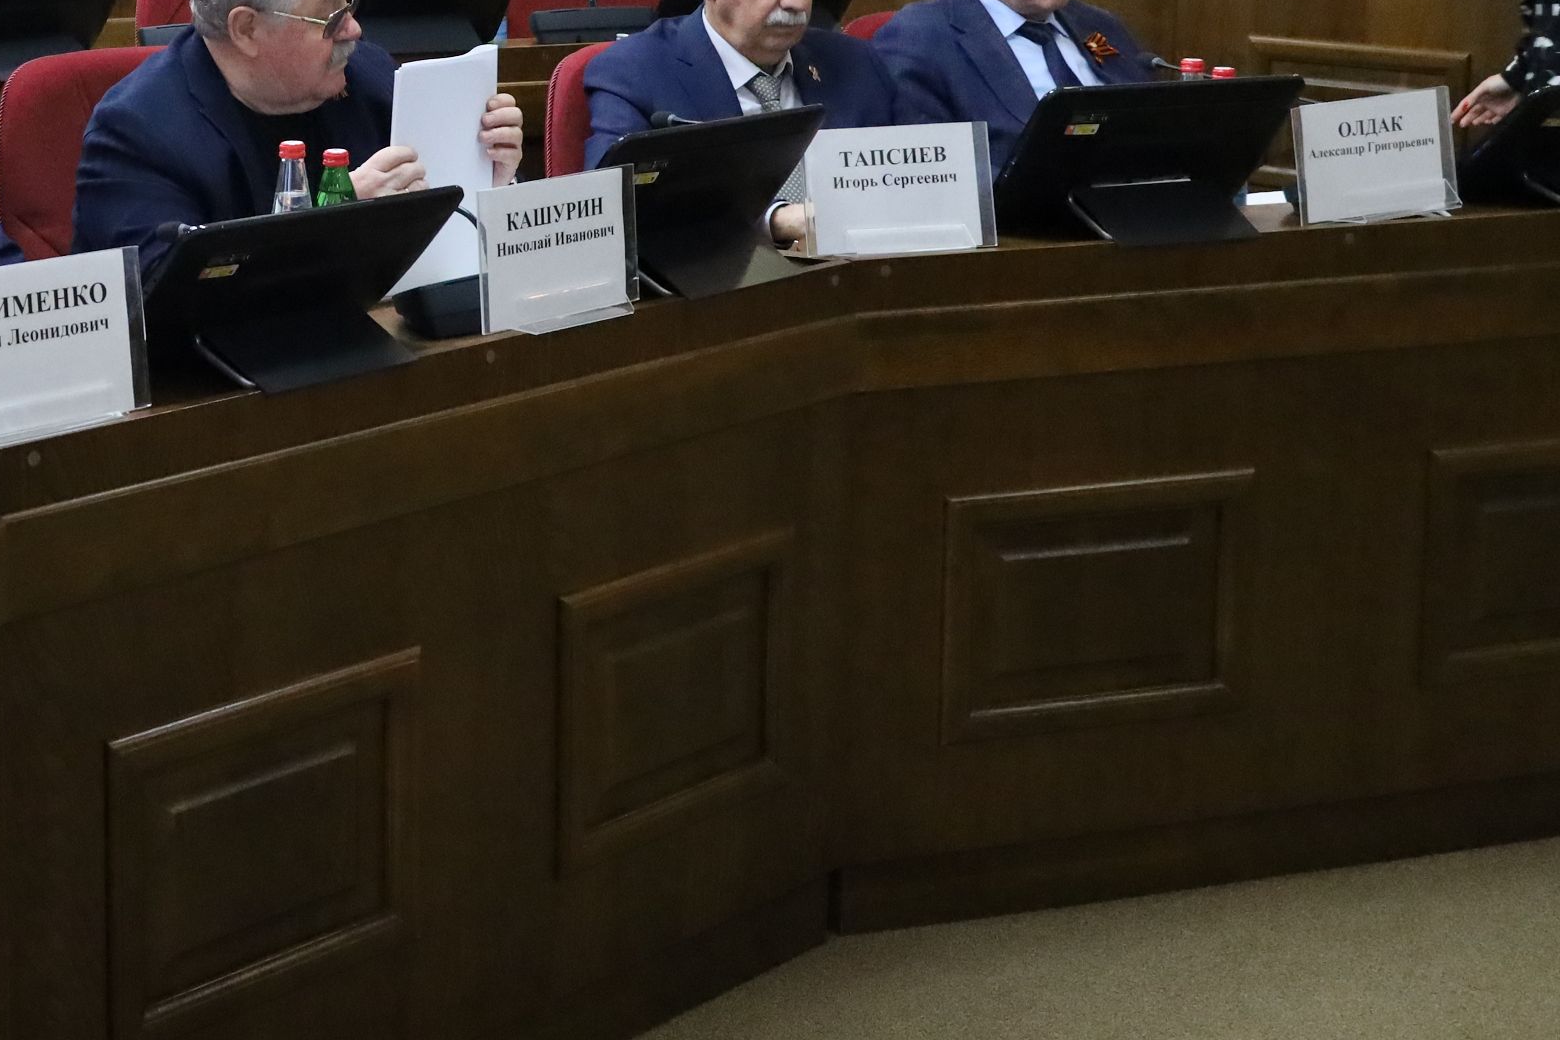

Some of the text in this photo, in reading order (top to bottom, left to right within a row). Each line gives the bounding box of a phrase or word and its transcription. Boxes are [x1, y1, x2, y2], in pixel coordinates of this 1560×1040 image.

[1338, 115, 1403, 138] ОЛДАК
[839, 146, 947, 168] ТАПСИЕВ
[1309, 136, 1435, 159] Александр Григорьевич
[833, 172, 957, 191] Игорь Сергеевич
[506, 196, 604, 232] КАШУРИН
[496, 225, 615, 258] Николай Иванович
[7, 317, 110, 347] Леонидович
